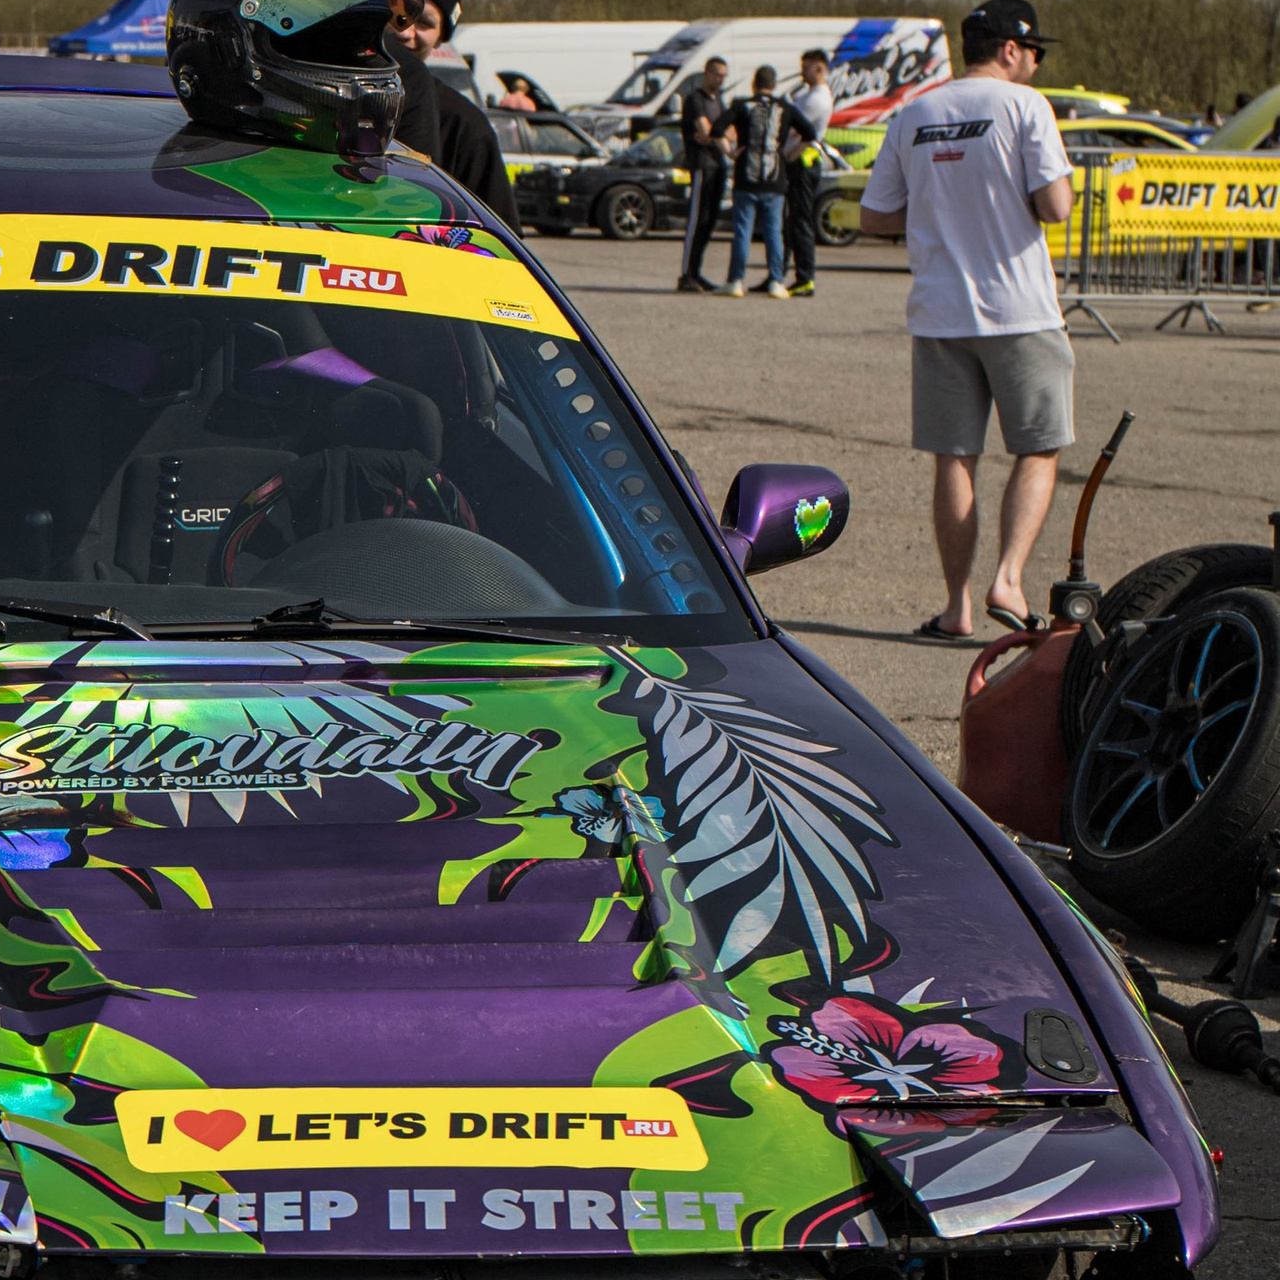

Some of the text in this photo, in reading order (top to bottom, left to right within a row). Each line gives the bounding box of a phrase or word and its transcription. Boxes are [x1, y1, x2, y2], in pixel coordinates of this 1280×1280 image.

[1141, 181, 1218, 210] DRIFT
[1226, 183, 1280, 212] TAXI
[3, 772, 298, 792] POWERED BY FOLLOWERS
[147, 1116, 165, 1145] I
[257, 1111, 428, 1142] LET'S
[164, 1187, 745, 1235] KEEP IT STREET
